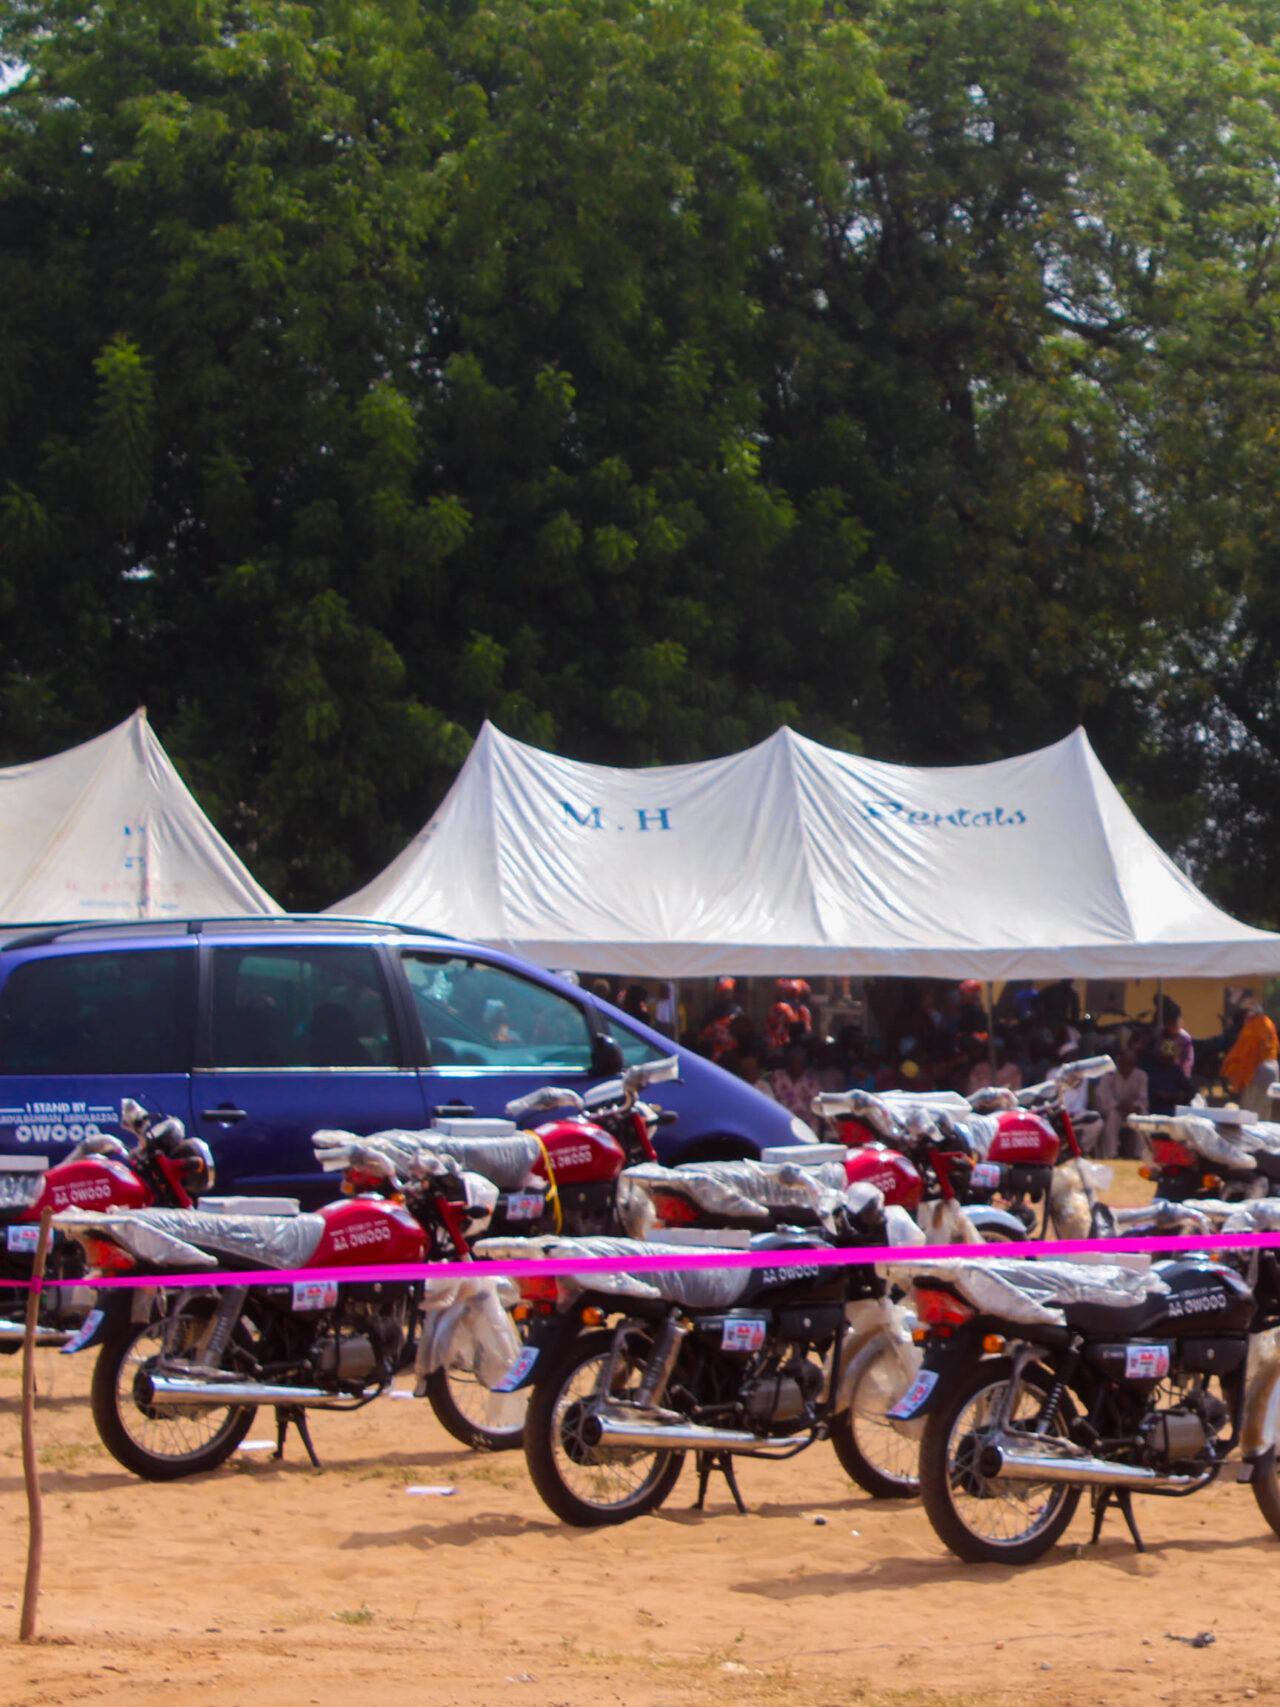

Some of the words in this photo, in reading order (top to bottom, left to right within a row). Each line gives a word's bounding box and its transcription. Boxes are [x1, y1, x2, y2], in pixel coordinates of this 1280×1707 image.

[33, 1102, 70, 1113] STAND
[72, 1102, 86, 1112] BY
[1168, 1302, 1184, 1317] AA
[1184, 1294, 1227, 1313] OWOOO
